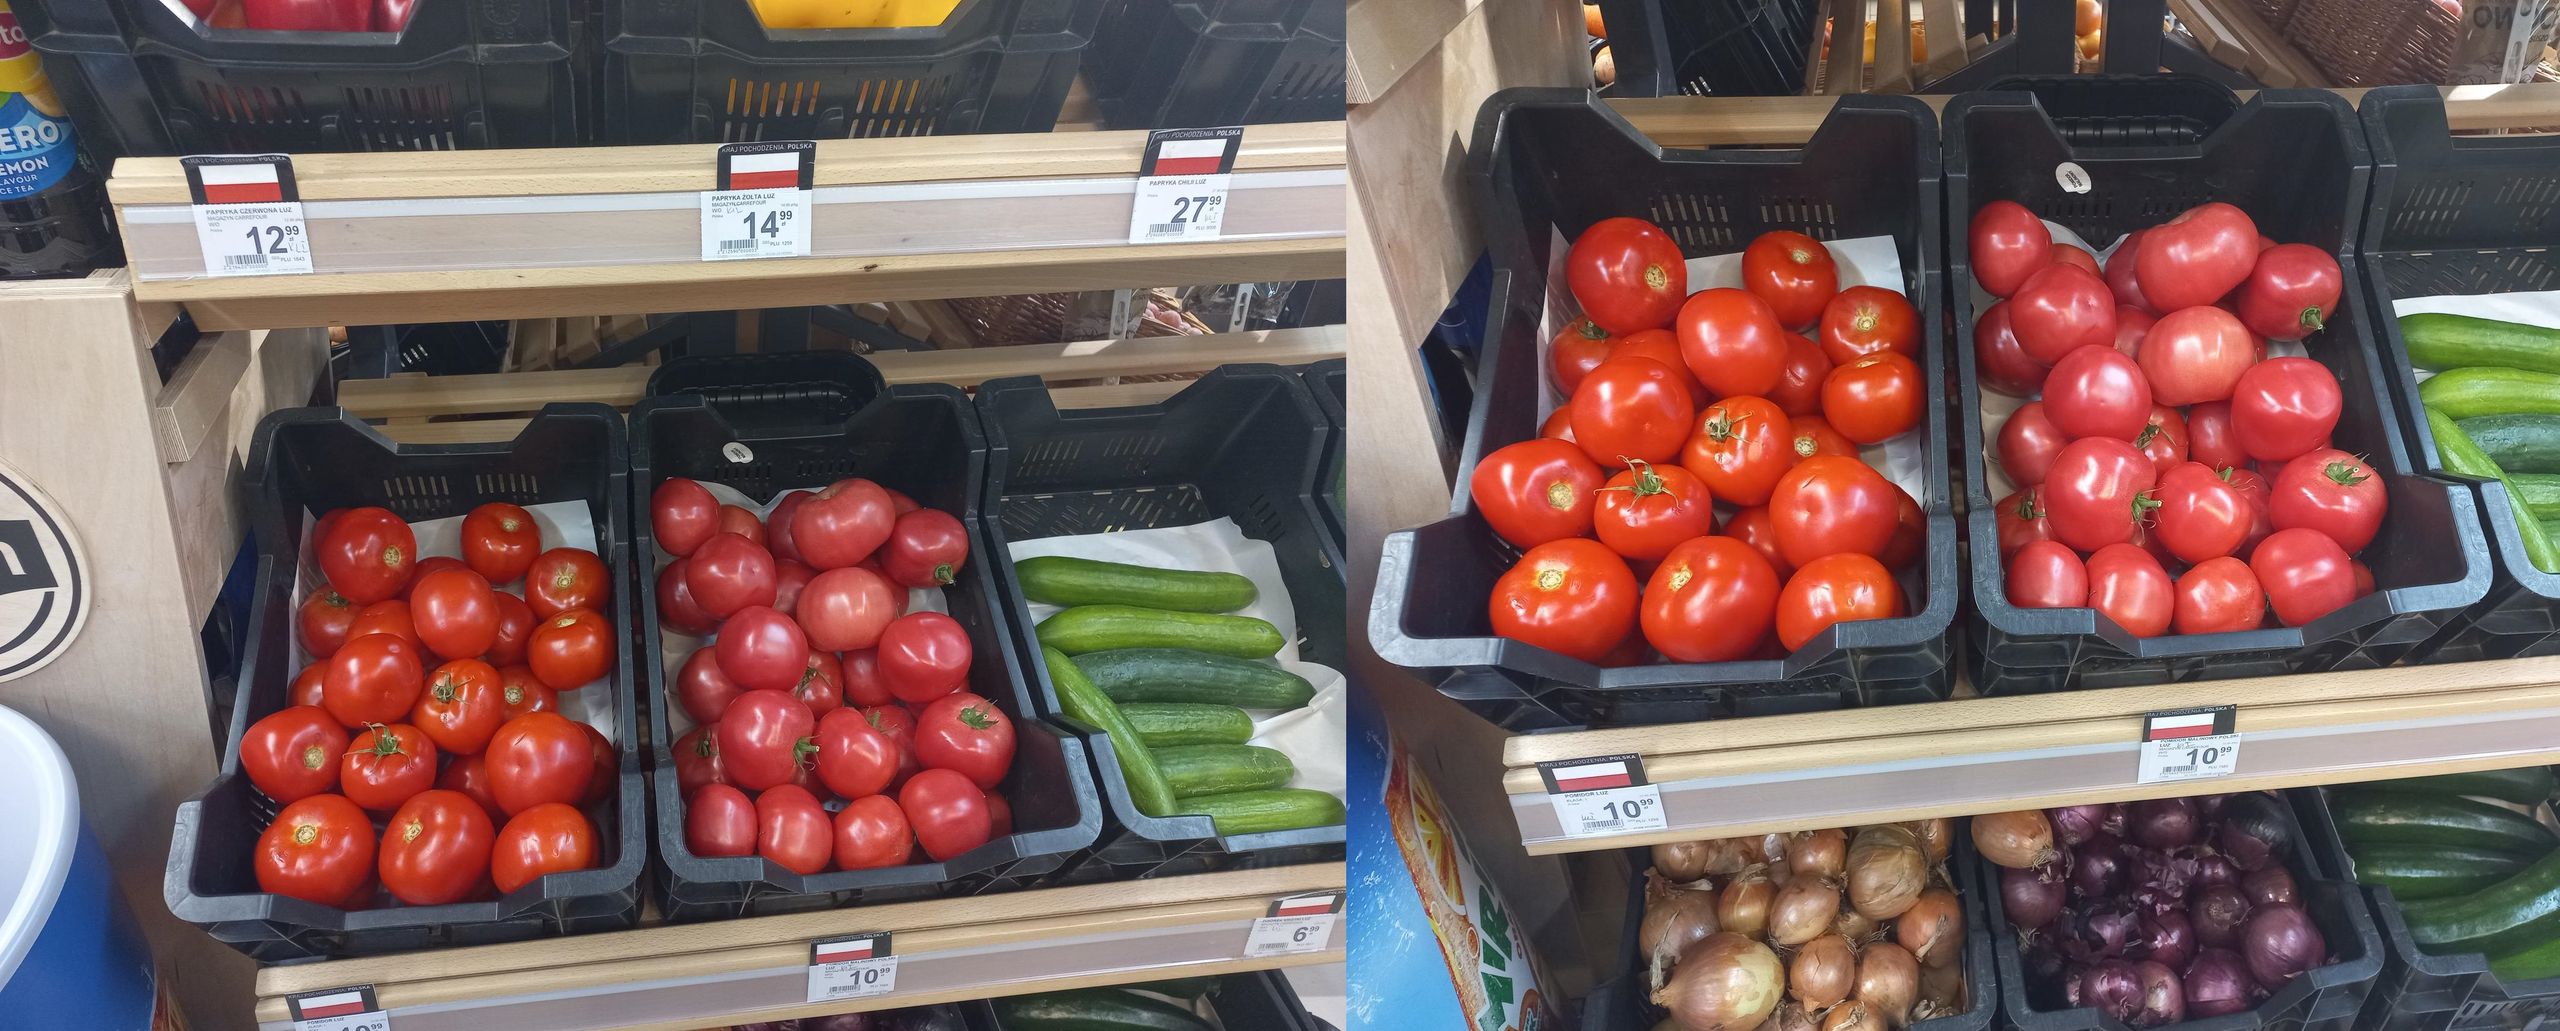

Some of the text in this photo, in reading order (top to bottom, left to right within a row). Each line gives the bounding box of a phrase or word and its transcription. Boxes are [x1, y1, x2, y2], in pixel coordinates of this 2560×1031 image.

[15, 184, 34, 193] TEA
[240, 207, 277, 215] CZERWONA
[1171, 195, 1221, 224] 27 99
[743, 210, 793, 240] 14 99
[246, 225, 300, 254] 12 99
[2186, 746, 2232, 766] 10 99
[1603, 800, 1641, 820] 10
[1640, 798, 1654, 806] 99
[1292, 926, 1309, 943] 6
[849, 968, 879, 986] 10
[370, 1022, 383, 1030] 99
